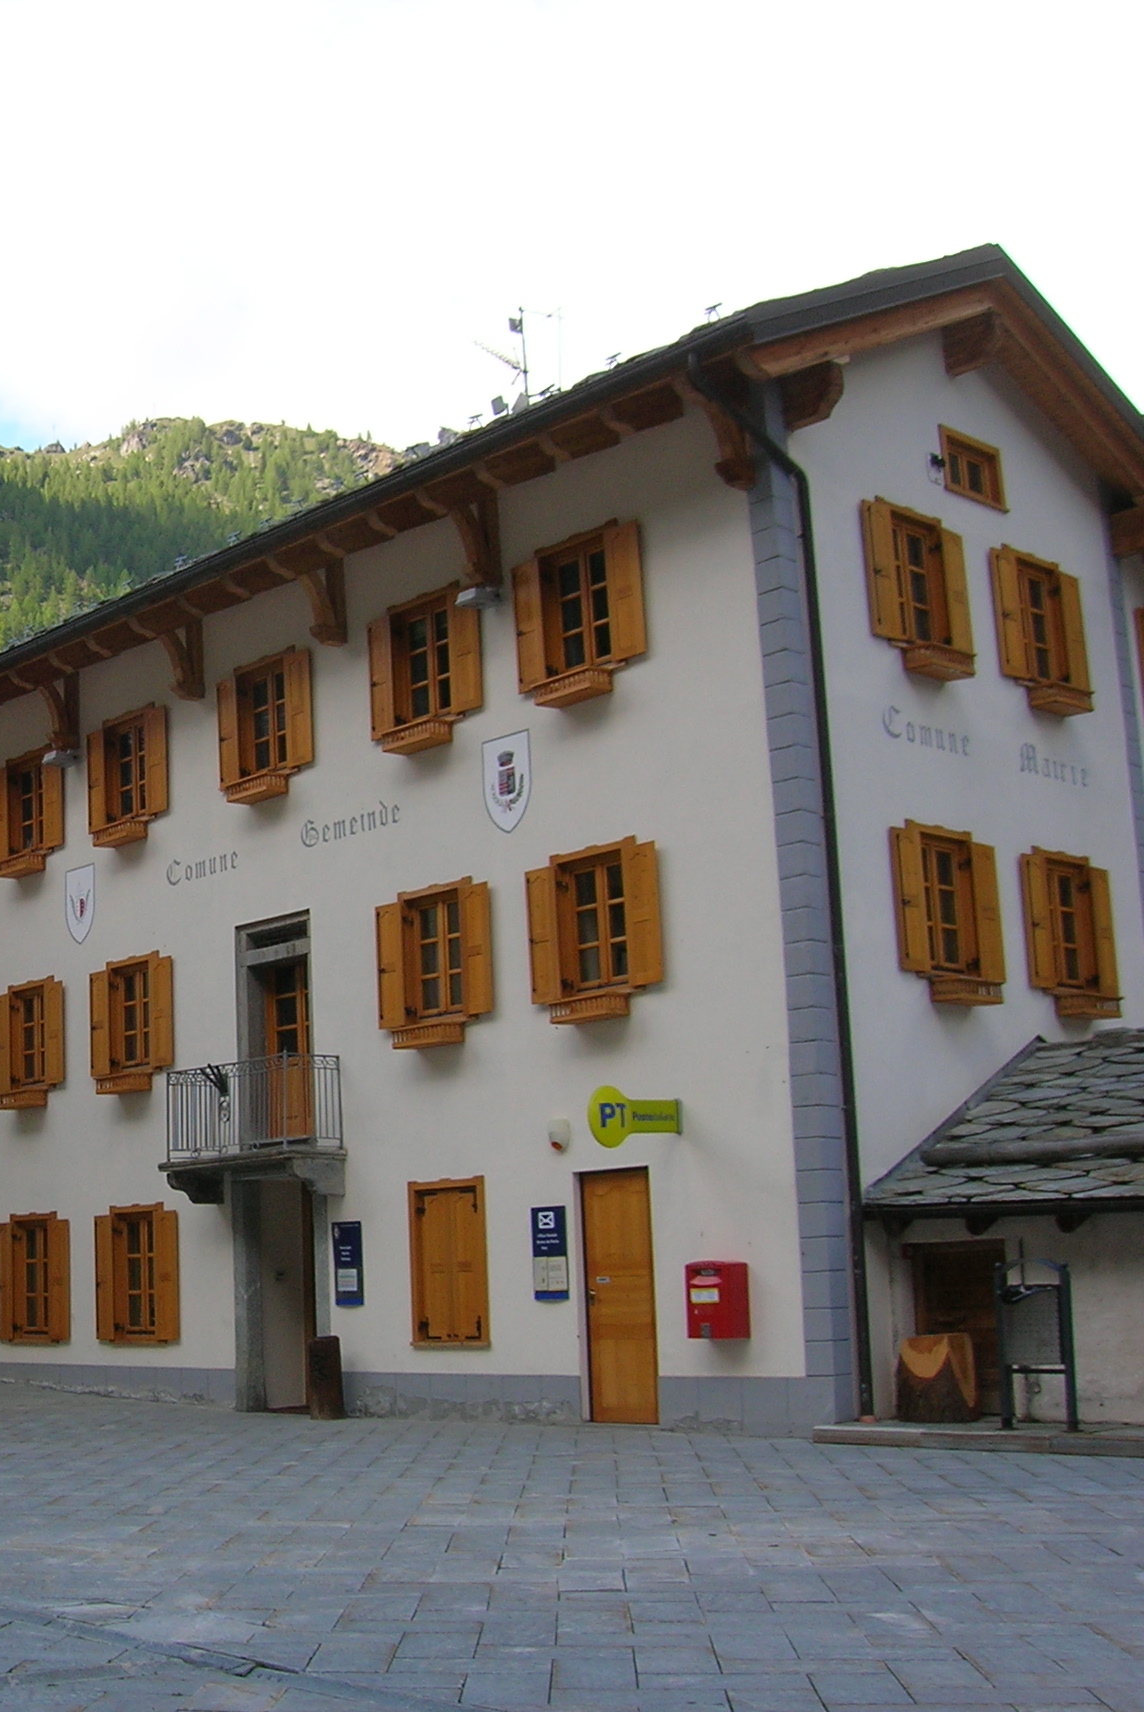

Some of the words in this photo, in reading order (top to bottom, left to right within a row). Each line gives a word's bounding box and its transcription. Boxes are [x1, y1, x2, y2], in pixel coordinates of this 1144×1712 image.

[882, 705, 970, 757] Comune
[1019, 742, 1089, 788] Mairie
[165, 850, 239, 886] Comune
[300, 799, 401, 848] Gemeinde
[598, 1102, 627, 1128] PT
